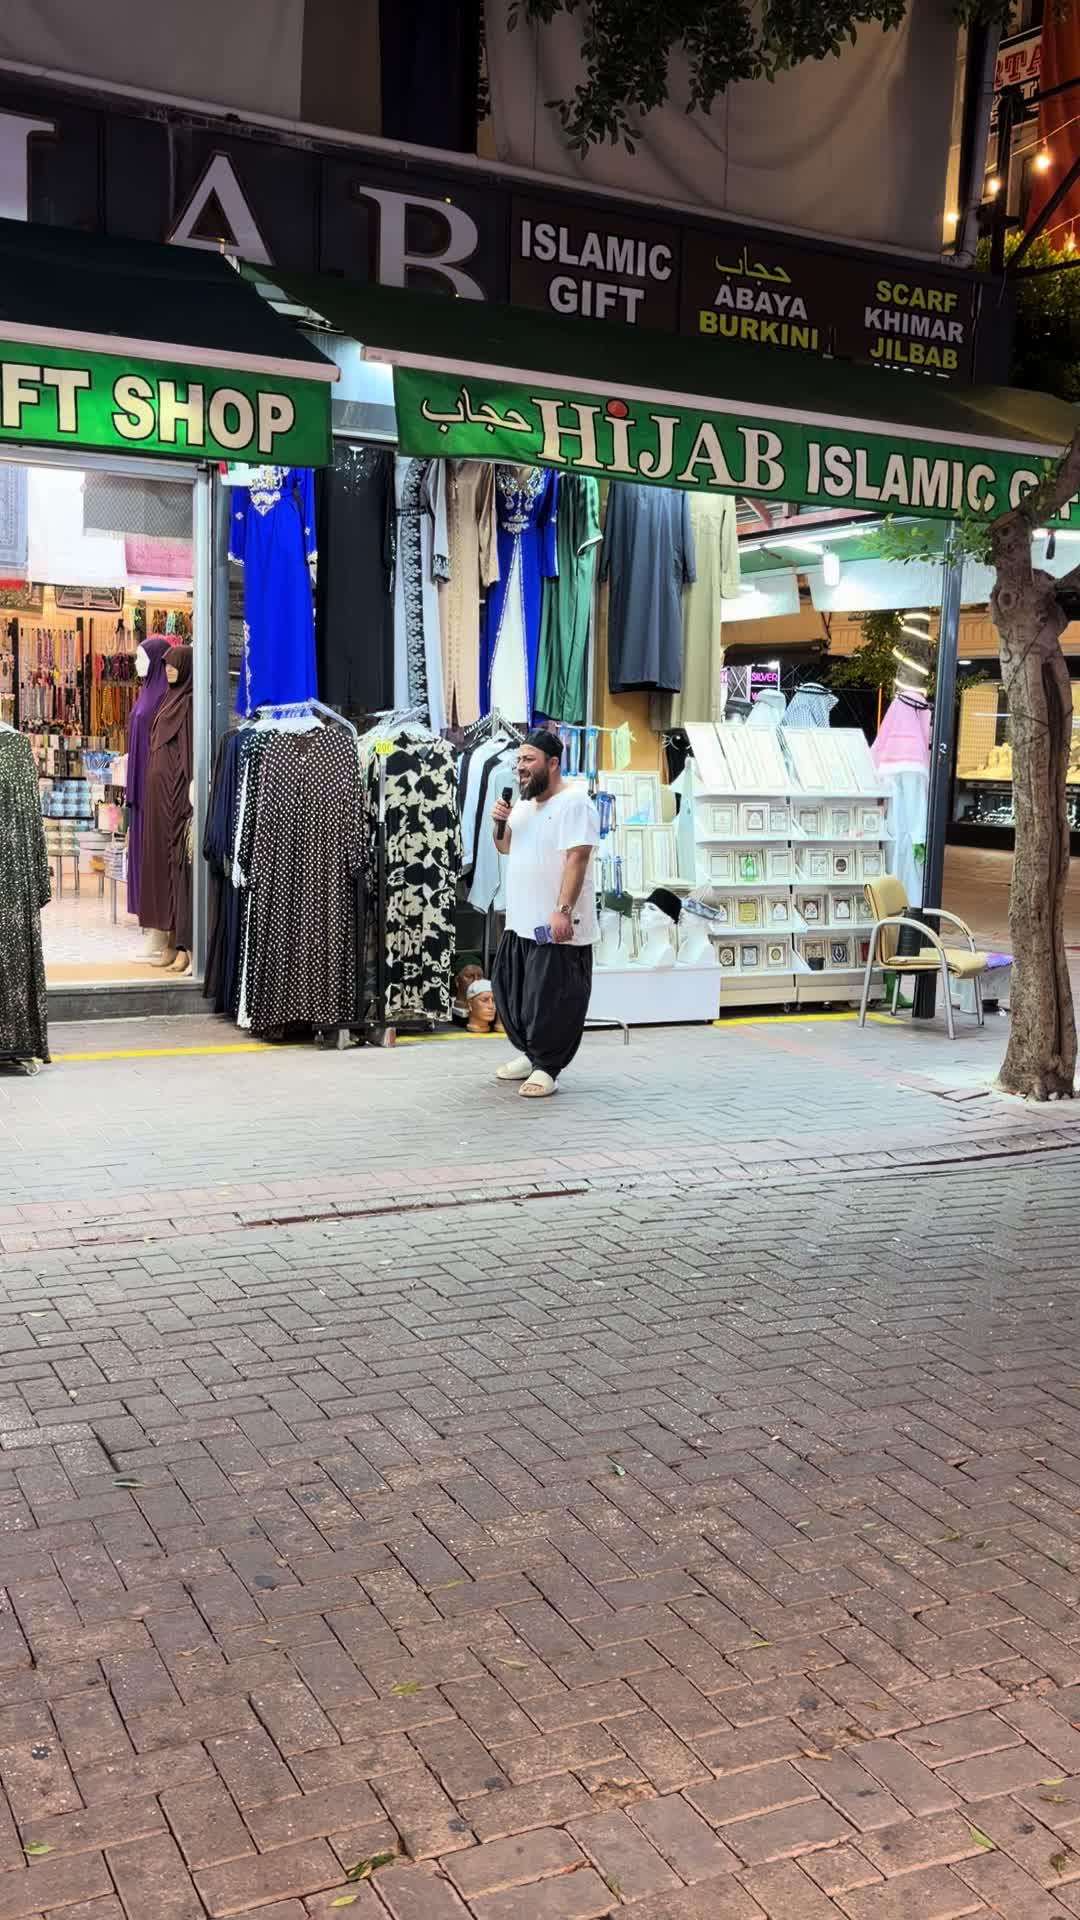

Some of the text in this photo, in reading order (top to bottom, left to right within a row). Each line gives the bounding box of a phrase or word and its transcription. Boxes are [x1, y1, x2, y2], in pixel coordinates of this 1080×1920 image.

[521, 220, 672, 281] ISLAMIC
[715, 246, 792, 286] حجاب
[549, 275, 645, 323] GIFT
[714, 284, 808, 320] ABAYA
[876, 280, 958, 313] SCARF
[699, 310, 818, 350] BURKINI
[864, 306, 964, 343] KHIMAR
[870, 337, 958, 369] JILBAB
[1, 362, 296, 454] FT SHOP
[420, 387, 533, 433] حجاب
[806, 443, 995, 512] ISLAMIC
[751, 672, 778, 682] SILVER
